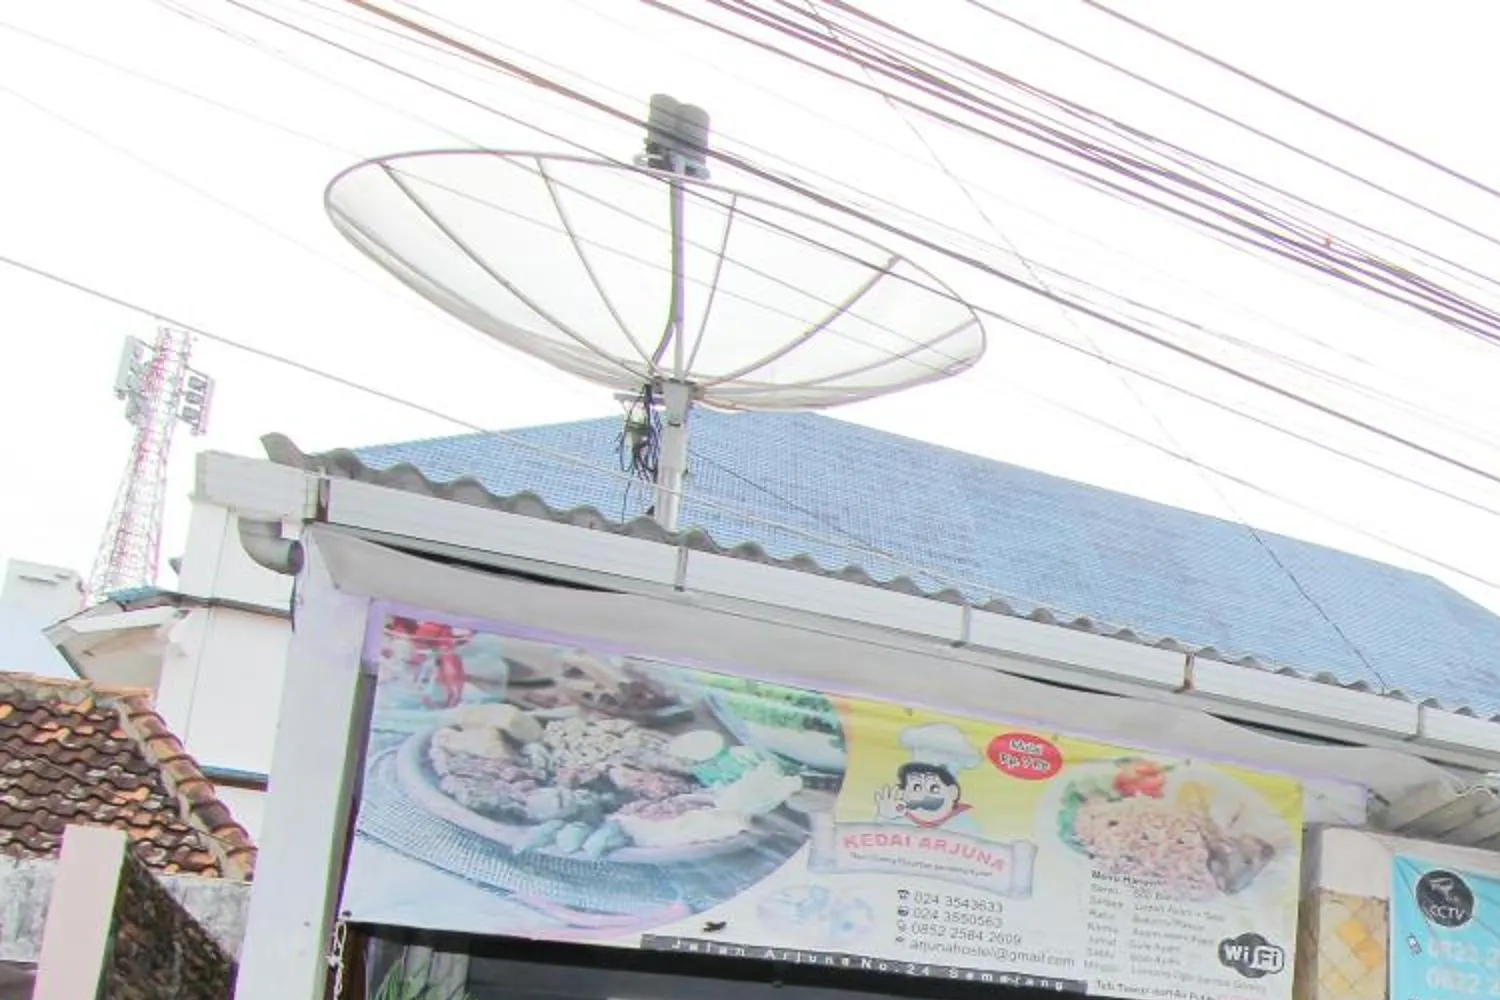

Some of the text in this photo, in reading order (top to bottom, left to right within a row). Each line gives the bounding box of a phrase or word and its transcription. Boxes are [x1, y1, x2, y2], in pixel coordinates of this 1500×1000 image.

[844, 833, 910, 849] KEDAI
[919, 836, 1007, 872] ARJUNA
[913, 891, 938, 905] 024
[1428, 904, 1466, 922] CCTV
[671, 938, 745, 957] Jalan
[764, 948, 850, 966] Arjuna
